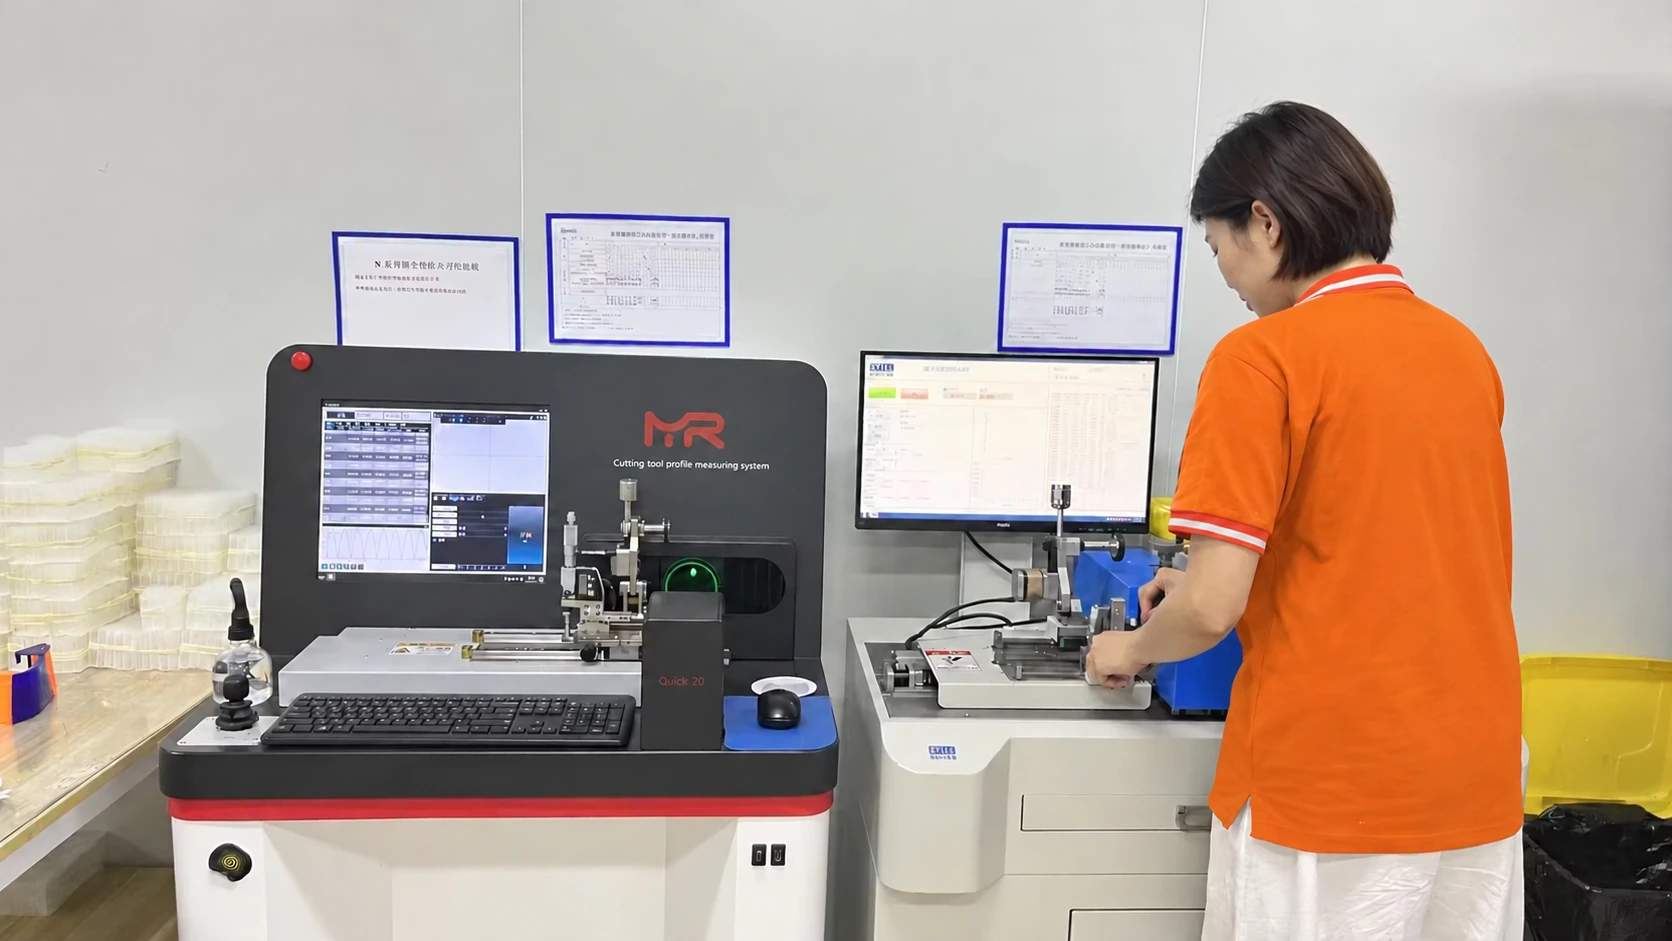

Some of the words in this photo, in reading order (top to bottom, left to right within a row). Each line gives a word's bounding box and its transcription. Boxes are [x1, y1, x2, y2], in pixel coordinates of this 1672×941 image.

[613, 458, 645, 470] Cutting
[647, 459, 664, 468] tool
[666, 459, 693, 470] profile
[695, 460, 739, 471] measuring
[740, 462, 770, 472] system
[658, 676, 688, 687] Quick
[692, 676, 705, 686] 20
